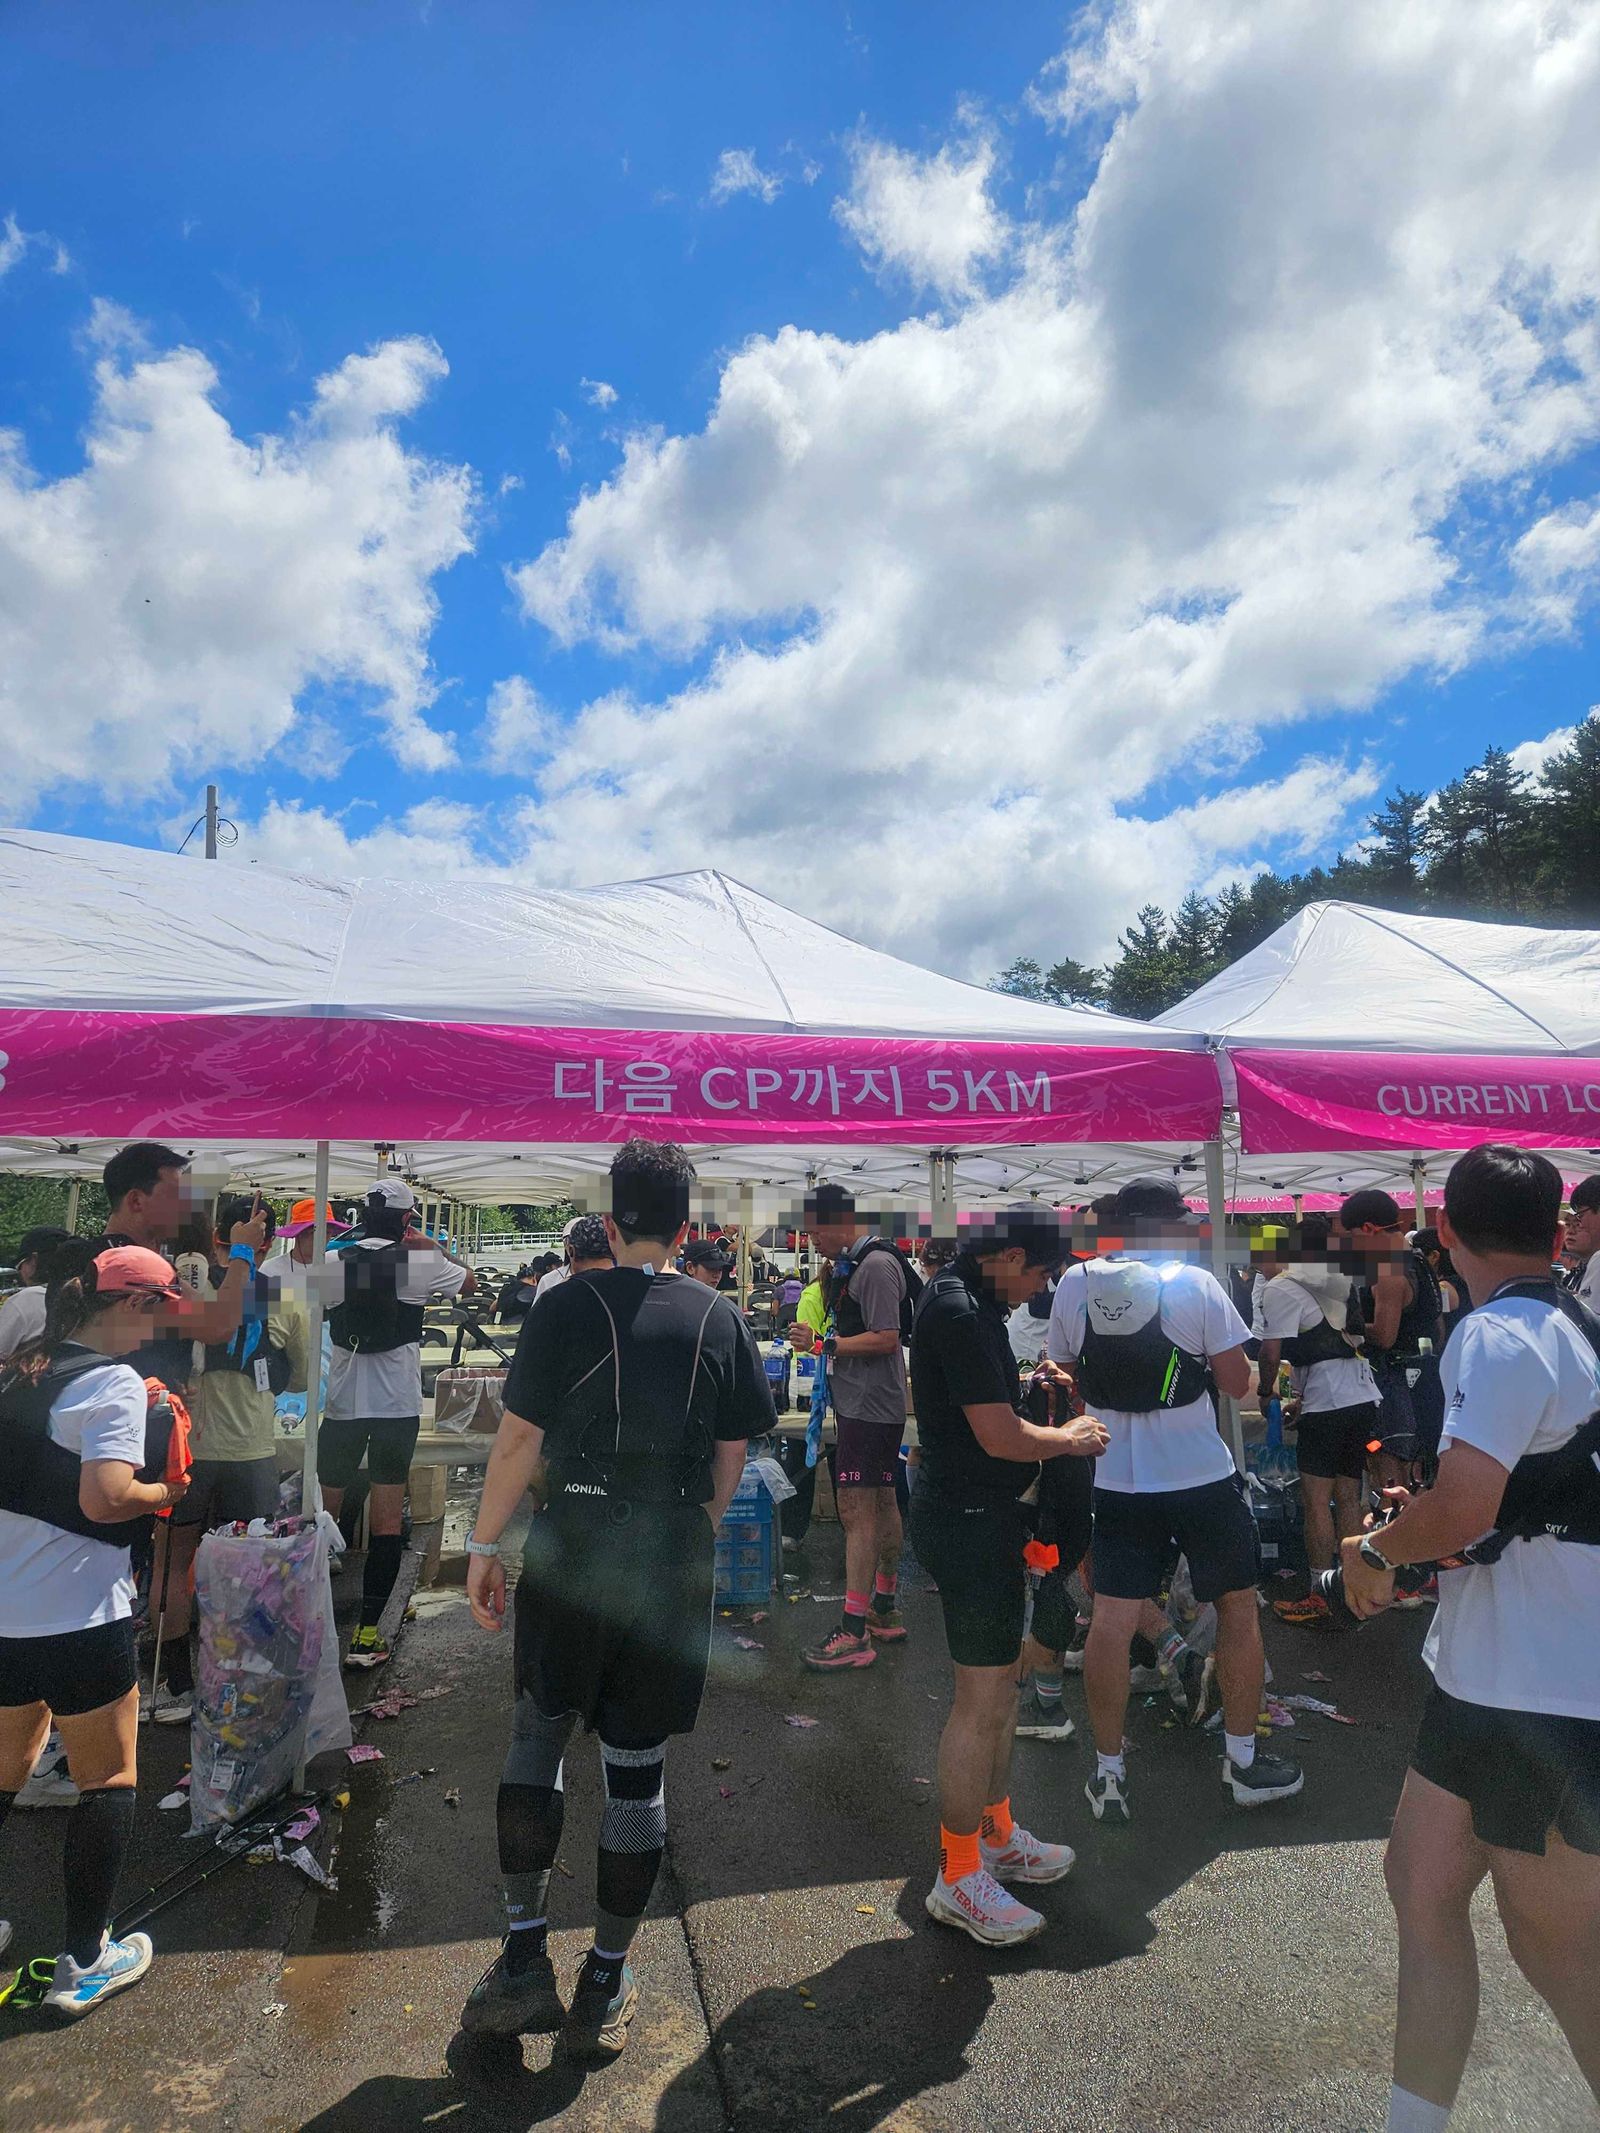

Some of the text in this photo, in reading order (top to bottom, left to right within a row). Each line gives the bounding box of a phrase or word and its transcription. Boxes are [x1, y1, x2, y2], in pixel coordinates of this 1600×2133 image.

[554, 1058, 1051, 1116] 다음 CP까지 5KM
[1377, 1084, 1550, 1115] CURRENT
[951, 1884, 989, 1926] TERREX
